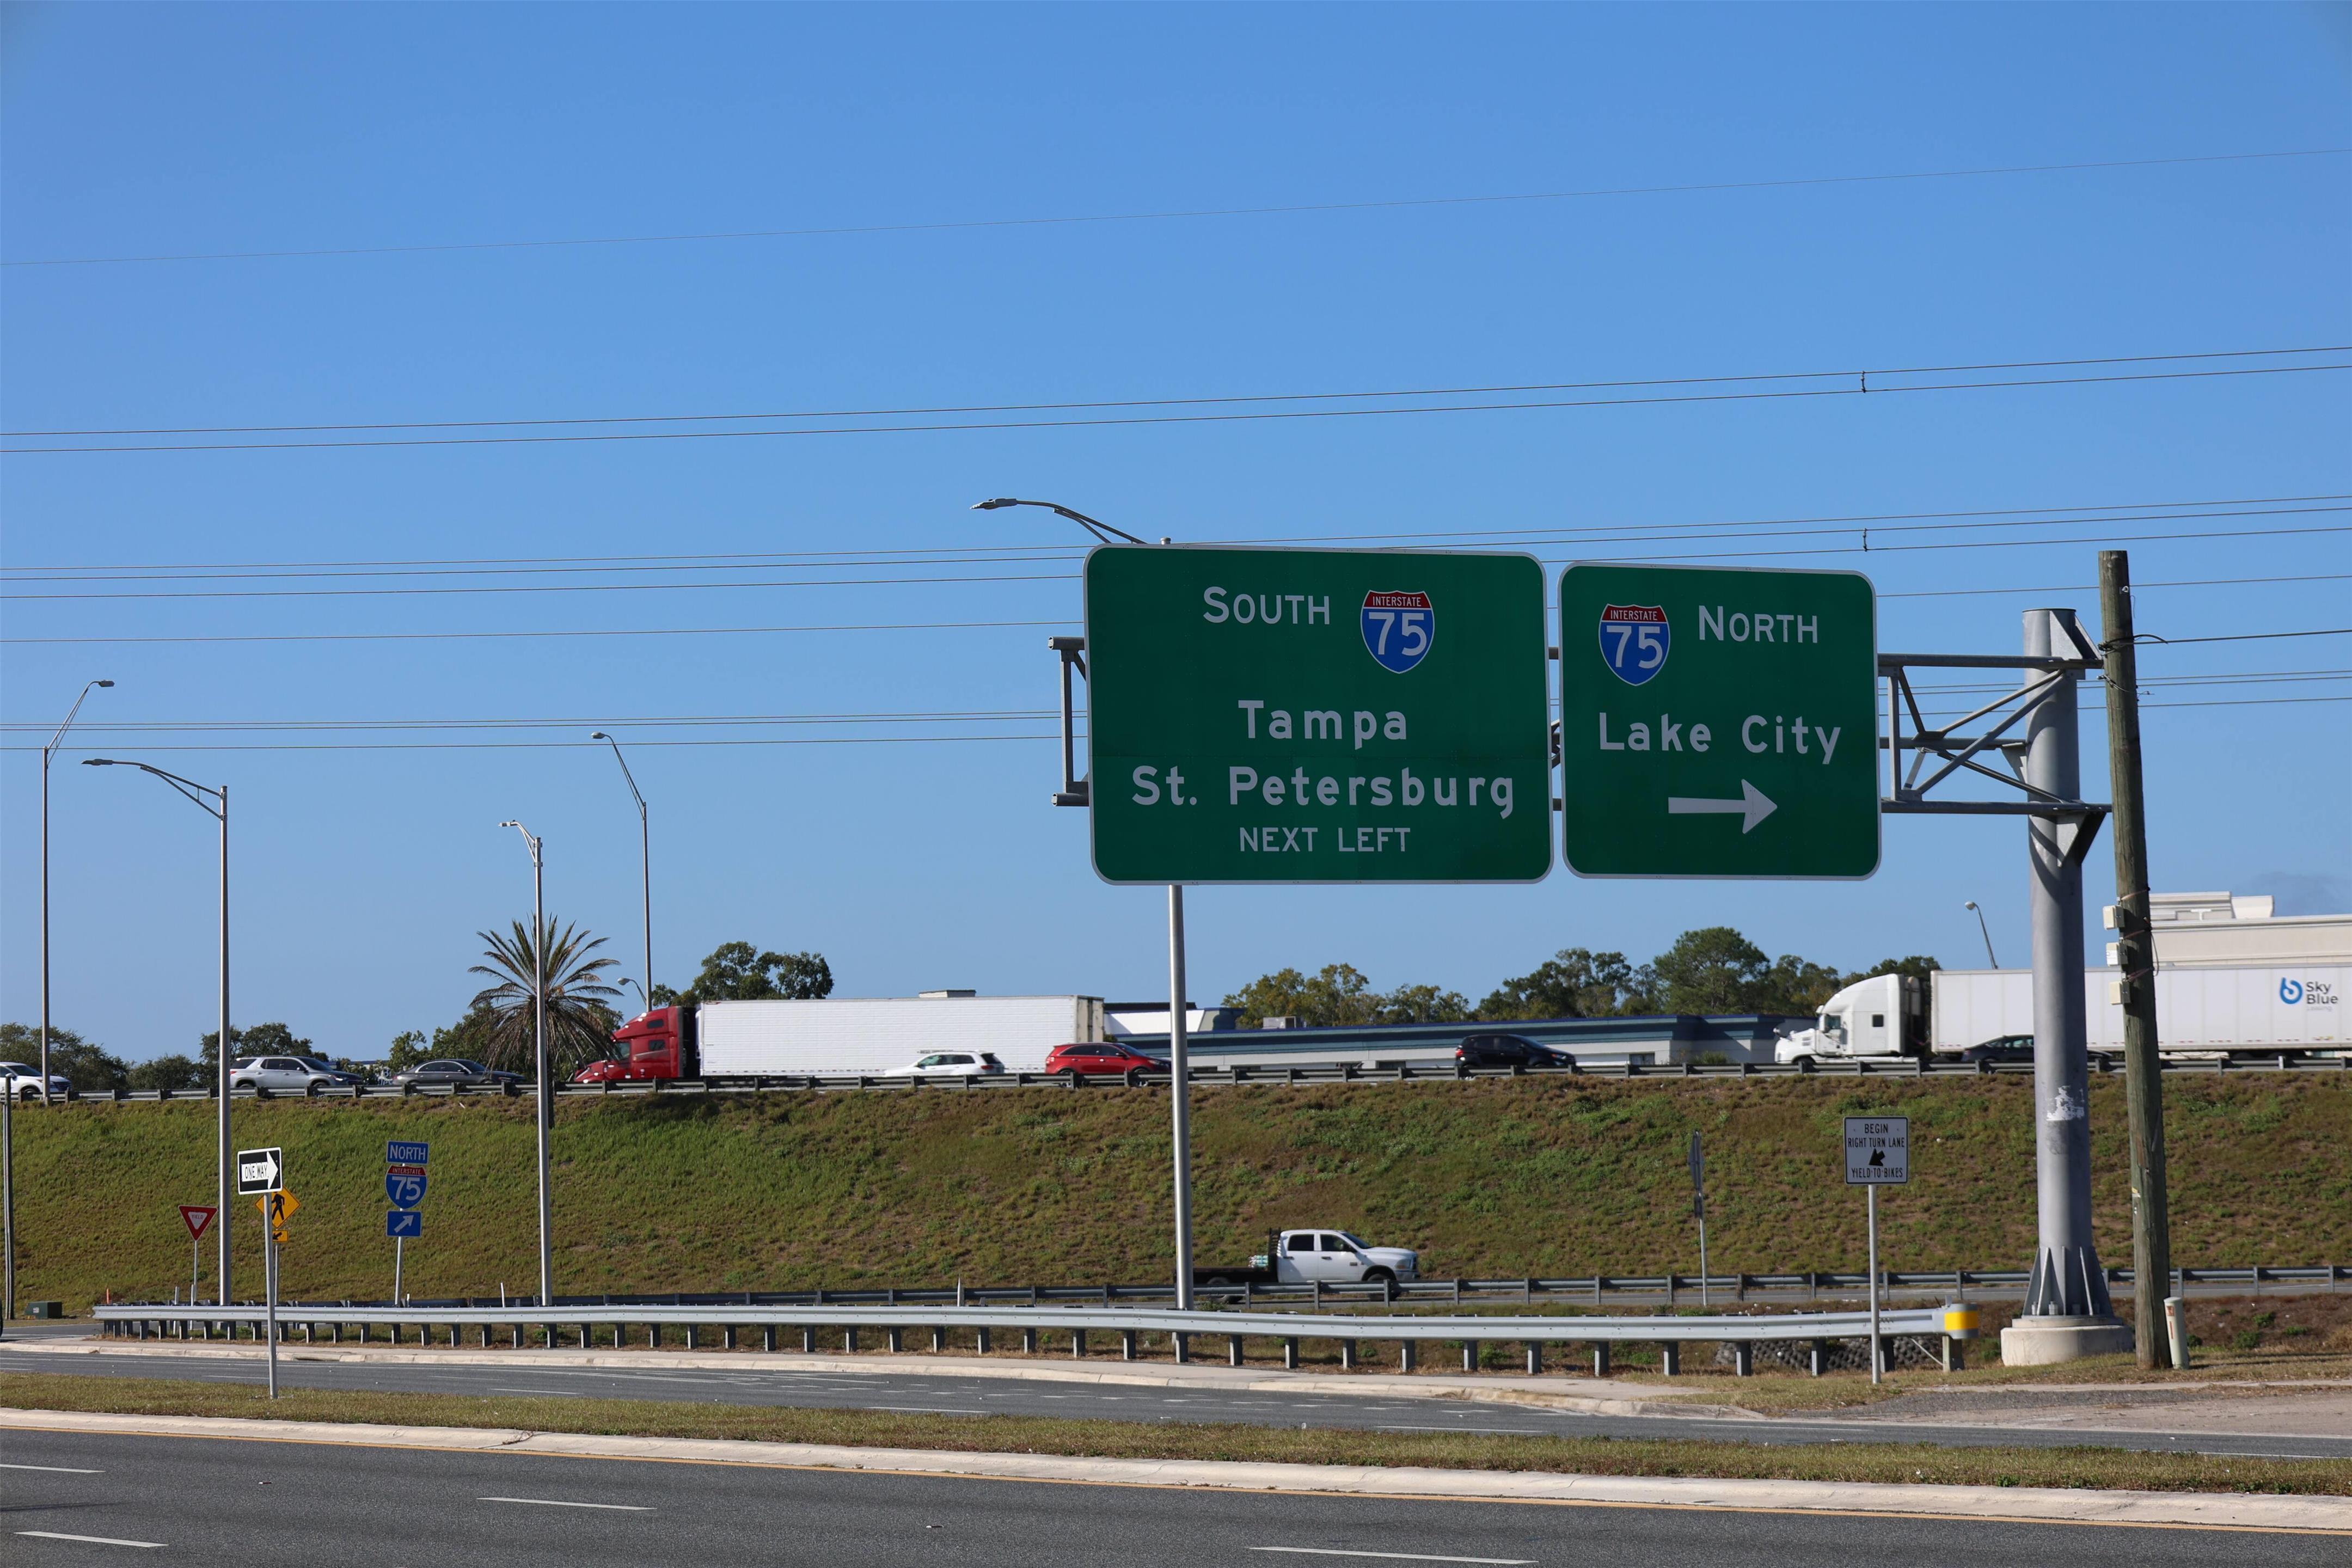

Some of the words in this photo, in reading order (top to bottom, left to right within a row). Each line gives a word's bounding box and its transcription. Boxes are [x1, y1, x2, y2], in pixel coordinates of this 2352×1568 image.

[1203, 586, 1330, 625] SOUTH
[1372, 596, 1422, 608] INTERSTATE
[1610, 609, 1658, 621] INTERSTATE
[1699, 605, 1818, 644] NORTH
[1368, 611, 1428, 656] 75
[1606, 626, 1663, 669] 75
[1238, 700, 1407, 750] Tampa
[1599, 712, 1712, 753] Lake
[1742, 714, 1841, 764] City
[1131, 765, 1197, 806] St.
[1229, 765, 1514, 820] Petersburg
[1240, 827, 1318, 852] NEXT
[1338, 828, 1411, 853] LEFT
[2306, 981, 2331, 995] Sky
[2306, 993, 2338, 1004] Blue
[1864, 1123, 1888, 1134] BEGIN
[390, 1144, 426, 1161] NORTH
[1848, 1137, 1866, 1148] RIGHT
[1869, 1137, 1885, 1148] TURN
[1888, 1137, 1904, 1148] LANE
[244, 1166, 255, 1180] ONE
[256, 1164, 267, 1179] WAY
[1851, 1168, 1871, 1178] YIELD
[1873, 1168, 1881, 1178] TO
[1884, 1167, 1903, 1178] BIKES
[391, 1176, 421, 1201] 75
